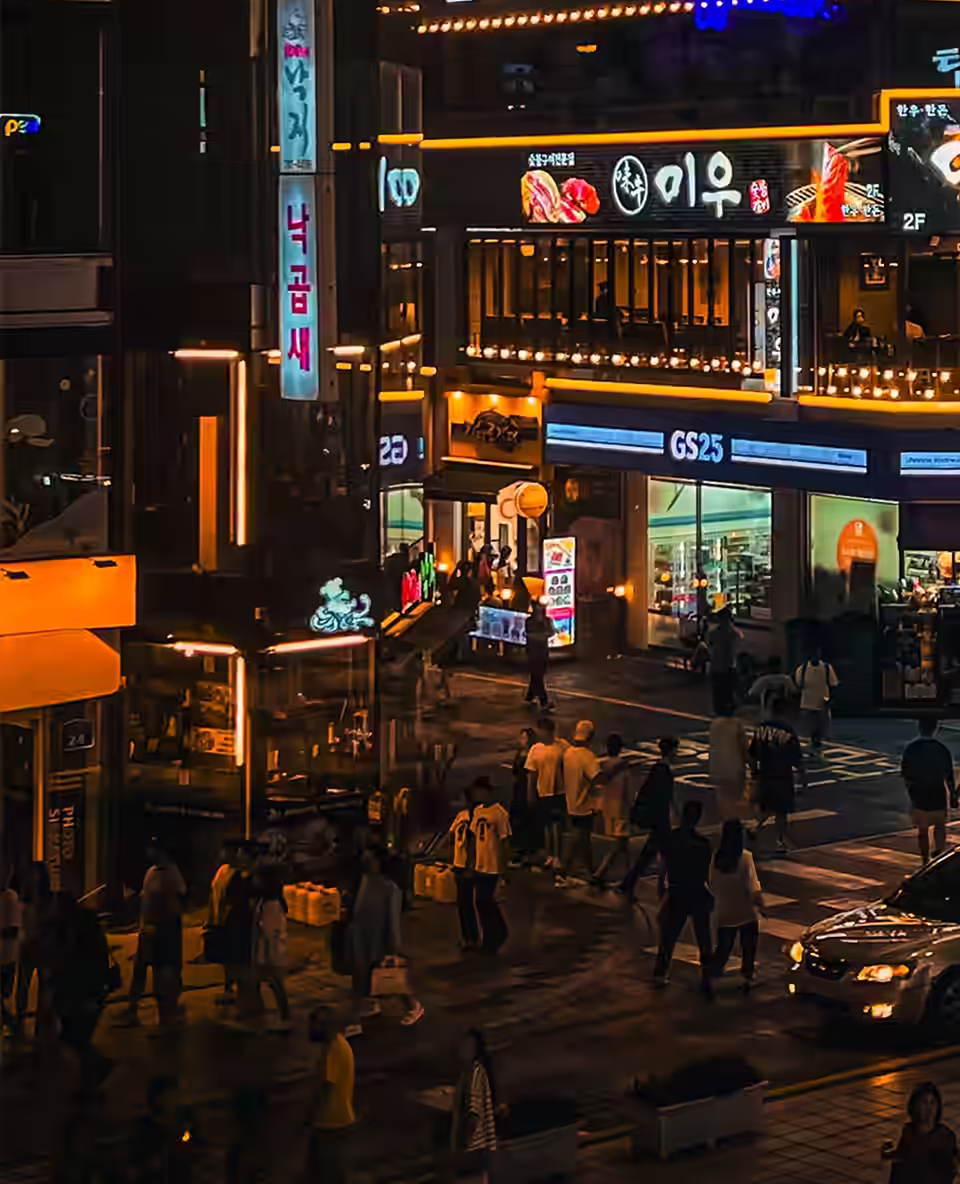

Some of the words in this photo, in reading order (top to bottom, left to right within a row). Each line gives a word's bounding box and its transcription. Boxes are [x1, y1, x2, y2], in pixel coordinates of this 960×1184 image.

[654, 151, 742, 218] 미우
[902, 212, 926, 231] 2F
[287, 202, 312, 373] 낙곱새
[669, 429, 724, 465] GS25
